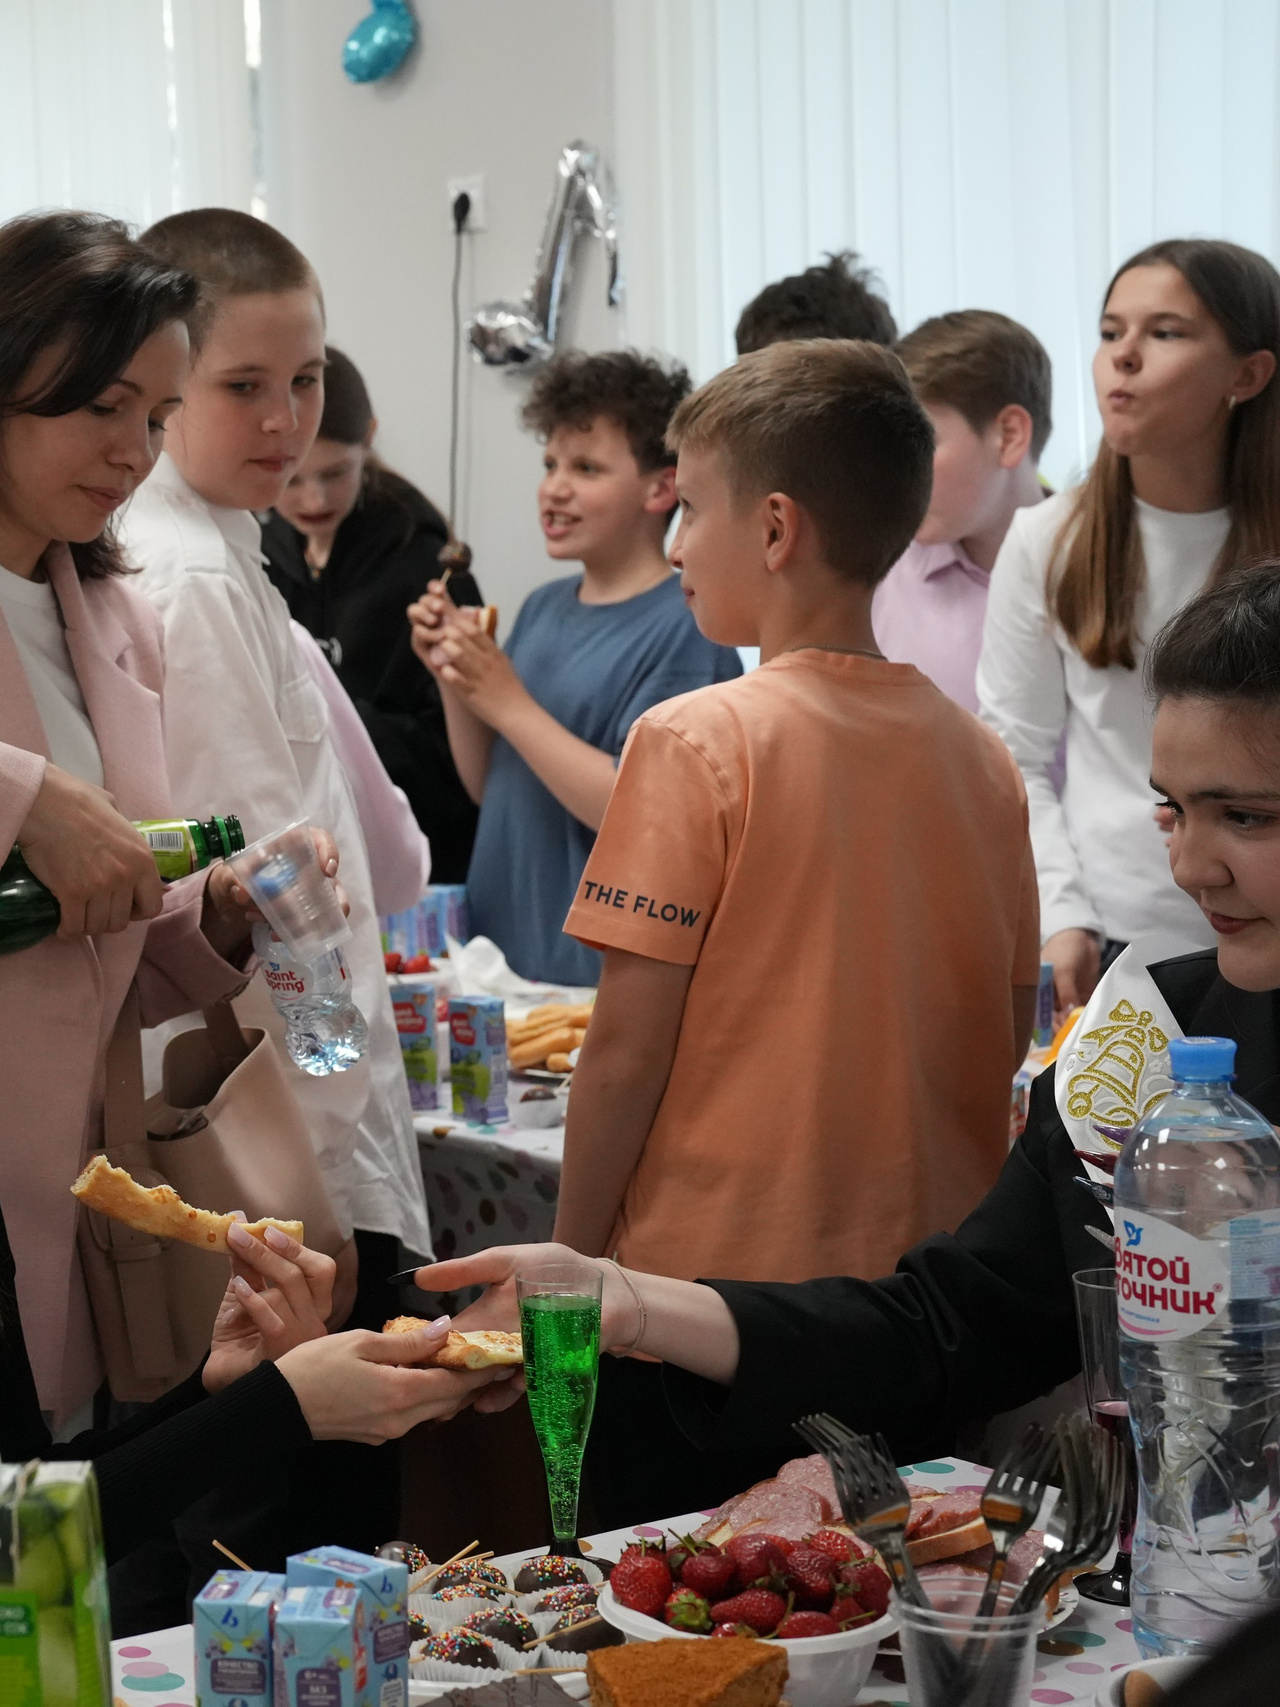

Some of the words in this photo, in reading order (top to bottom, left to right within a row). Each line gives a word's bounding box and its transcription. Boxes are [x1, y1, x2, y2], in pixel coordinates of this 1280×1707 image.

[585, 880, 629, 909] THE
[633, 895, 701, 928] FLOW
[1115, 1236, 1190, 1286] вятой
